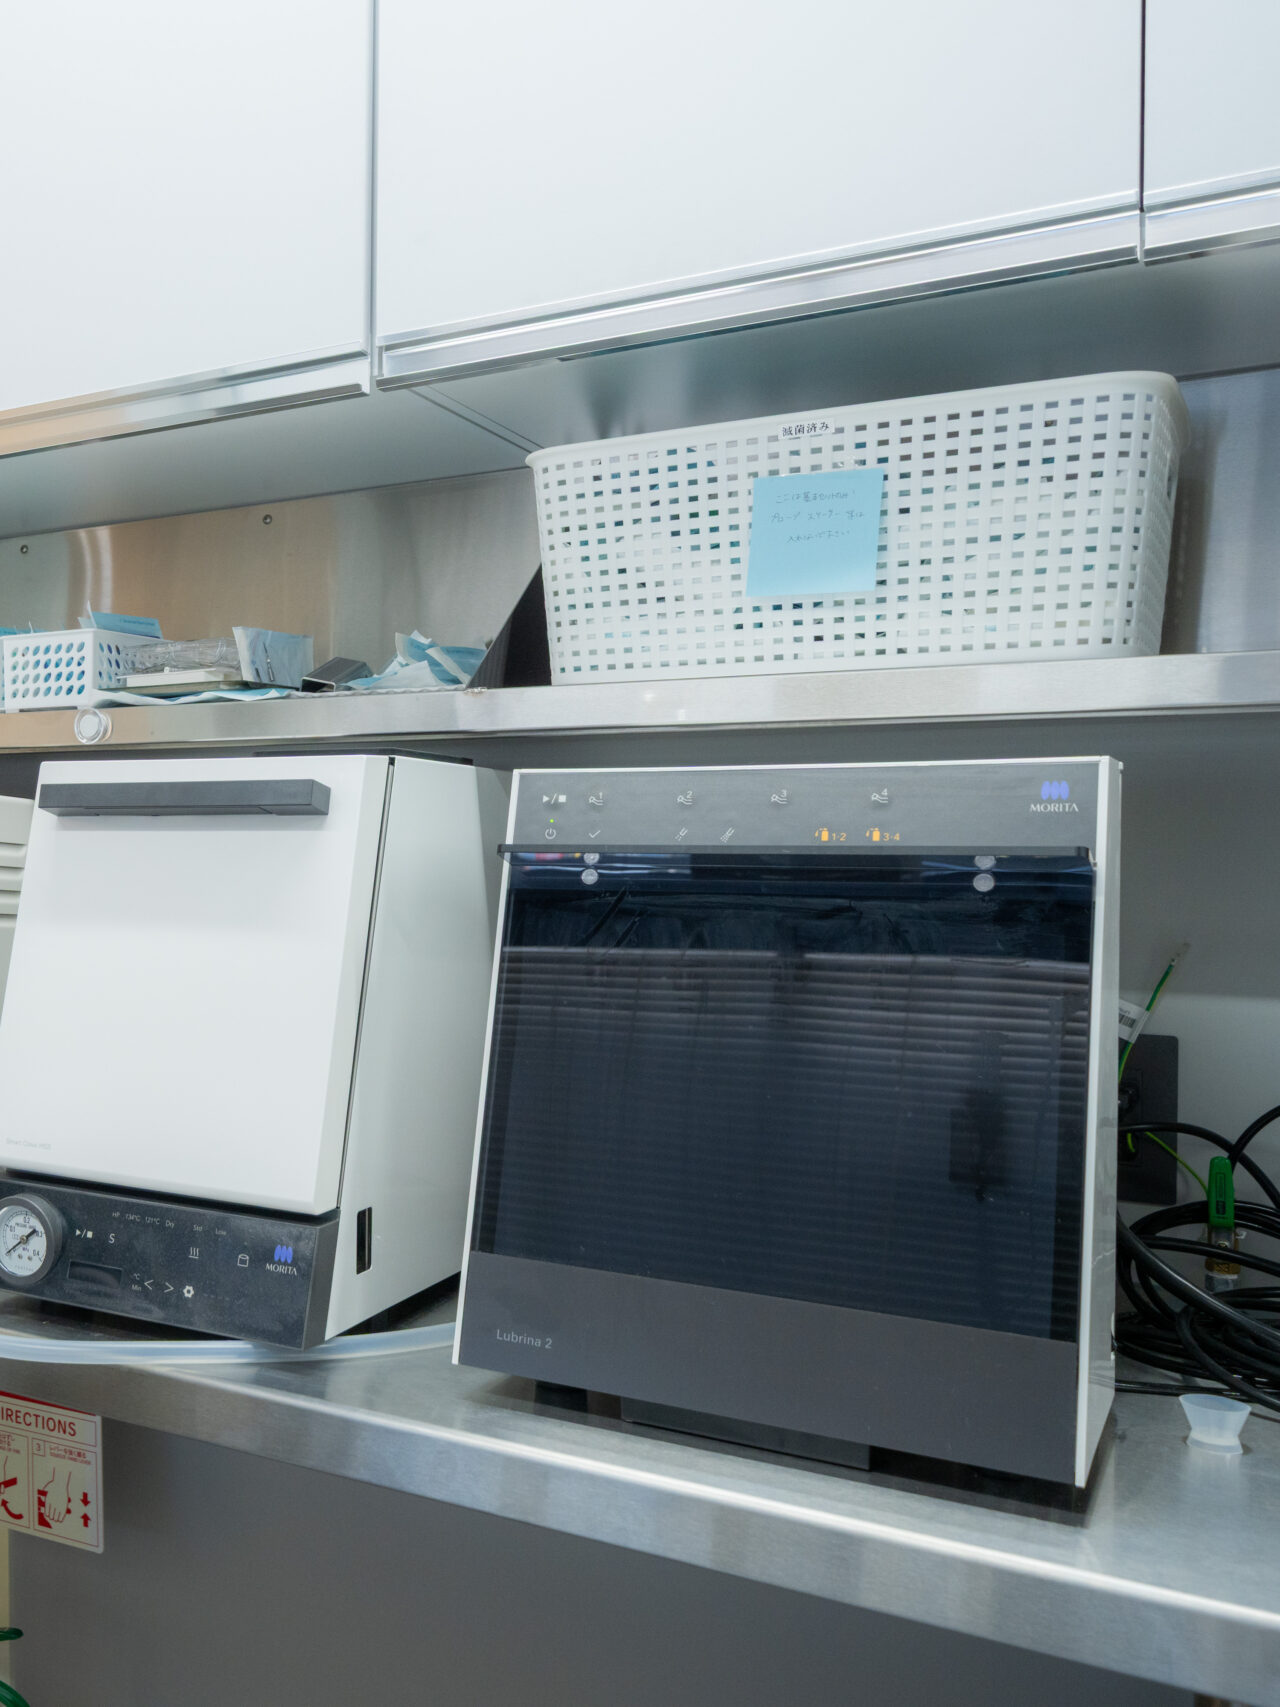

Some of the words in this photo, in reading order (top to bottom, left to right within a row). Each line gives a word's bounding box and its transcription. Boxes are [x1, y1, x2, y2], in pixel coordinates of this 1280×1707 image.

[782, 421, 829, 437] 滅菌済み
[686, 790, 693, 799] 2
[780, 789, 787, 798] 3
[881, 788, 888, 797] 4
[1029, 802, 1079, 813] MORITA
[108, 1233, 115, 1244] S
[265, 1262, 297, 1276] MORITA
[496, 1328, 541, 1347] Lubrina
[545, 1337, 553, 1349] 2
